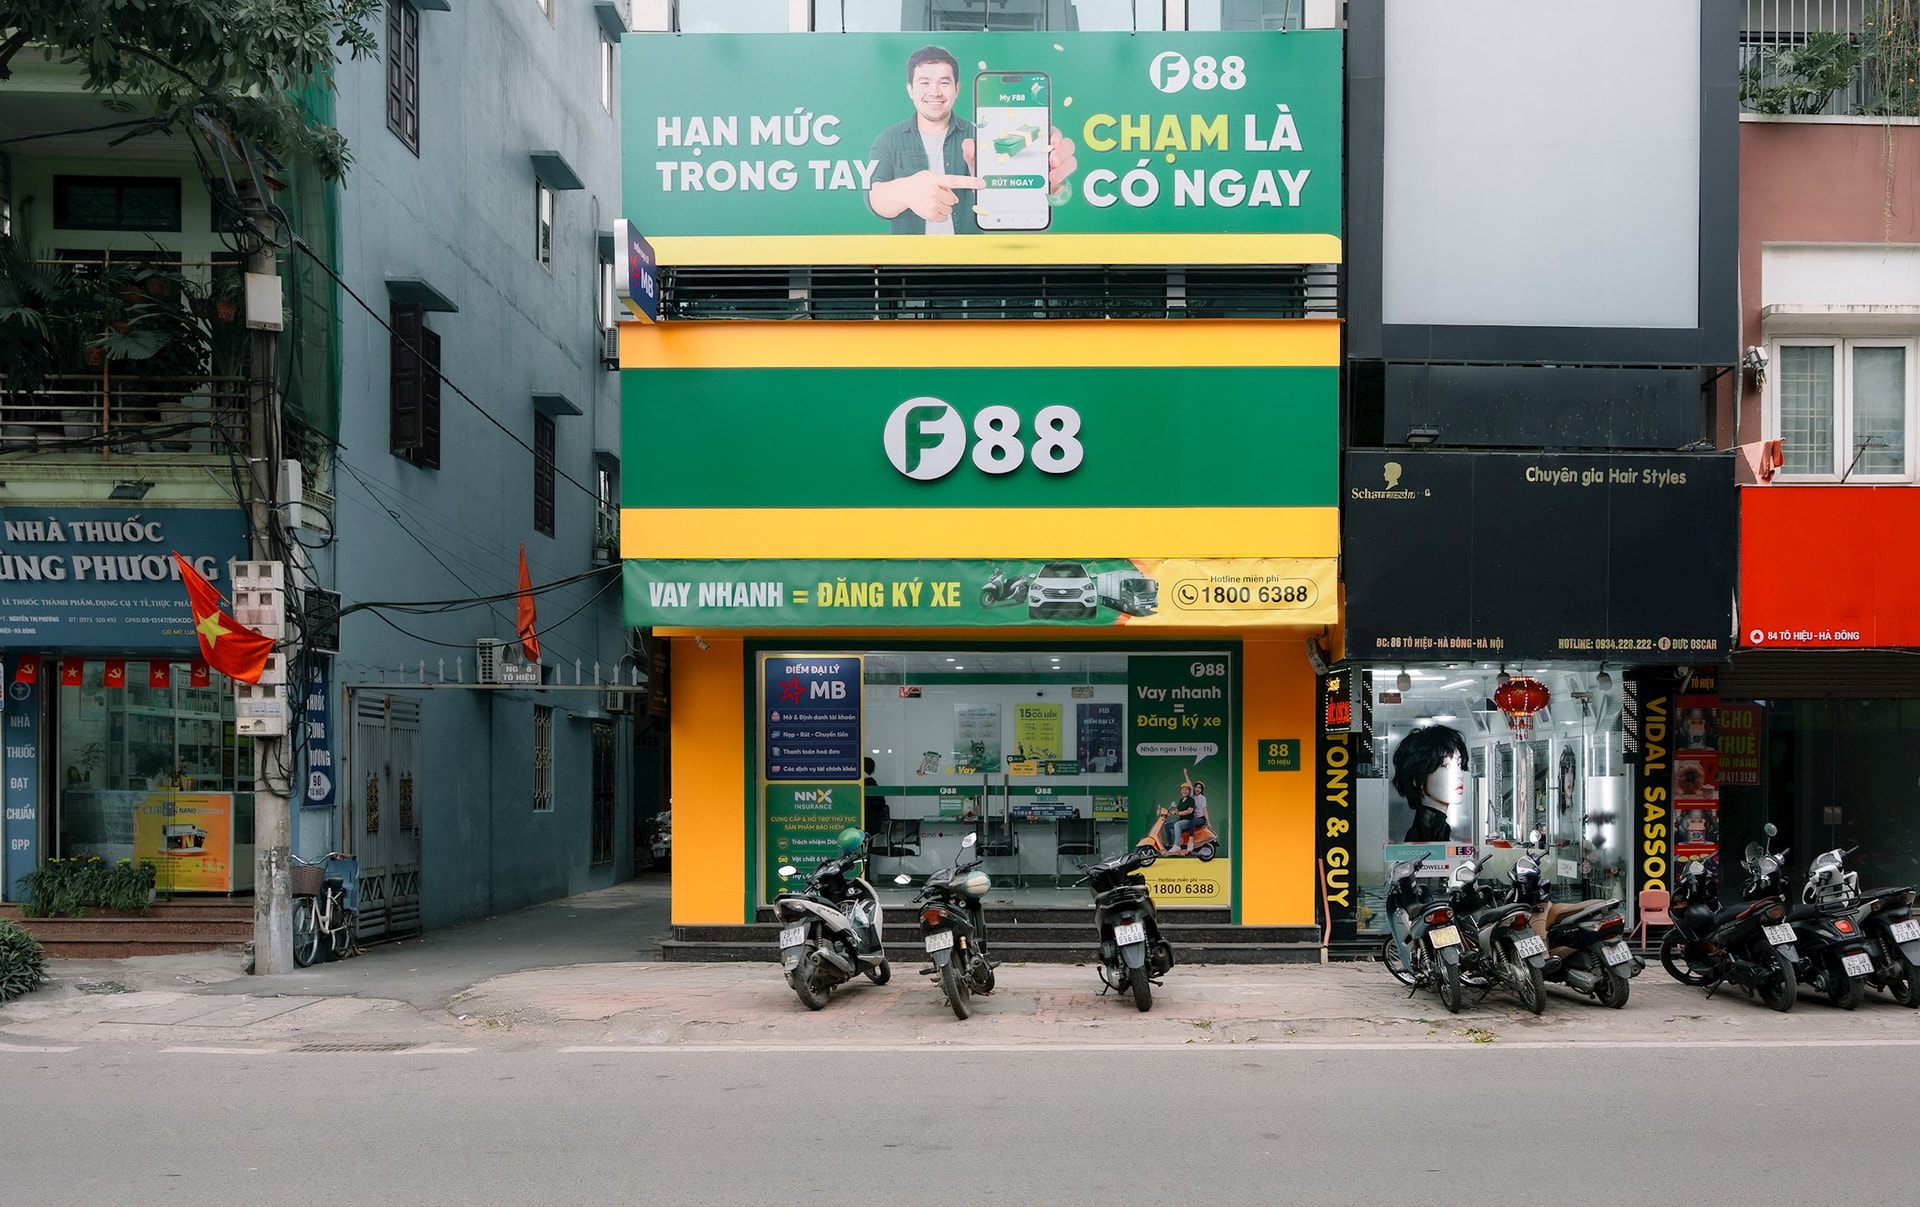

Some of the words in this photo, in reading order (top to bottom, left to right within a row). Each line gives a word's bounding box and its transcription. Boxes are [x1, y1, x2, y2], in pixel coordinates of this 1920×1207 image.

[1149, 51, 1246, 93] F88
[657, 116, 738, 156] HẠN
[750, 107, 841, 146] MỨC
[1083, 113, 1229, 164] CHẠM
[1245, 104, 1303, 151] LÀ
[656, 160, 798, 192] TRONG
[808, 159, 879, 191] TAY
[992, 176, 1007, 186] RÚT
[1083, 159, 1160, 207] CÓ
[1174, 169, 1311, 207] NGAY
[641, 267, 653, 298] MB
[884, 396, 1084, 480] F88
[1526, 466, 1577, 486] Chuyên
[1582, 468, 1603, 486] gia
[1609, 468, 1638, 483] Hair
[1642, 468, 1686, 488] Styles
[4, 516, 66, 542] NHÀ
[68, 514, 164, 542] THUỐC
[1210, 575, 1239, 583] Hotline
[1243, 574, 1265, 583] miễn
[1266, 574, 1280, 584] phí
[649, 582, 691, 607] VAY
[699, 582, 783, 607] NHANH
[817, 577, 884, 607] ĐĂNG
[892, 577, 923, 607] KÝ
[930, 582, 961, 607] XE
[1202, 586, 1250, 603] 1800
[1258, 586, 1308, 603] 6388
[13, 597, 39, 606] THUỐC
[1768, 632, 1777, 640] 84
[1780, 629, 1790, 640] TÔ
[1834, 630, 1859, 640] ĐÔNG
[1376, 637, 1389, 647] ĐC:
[1391, 637, 1400, 647] 86
[1403, 636, 1413, 647] TÔ
[1490, 637, 1504, 650] NỘI
[1558, 638, 1593, 649] HOTLINE:
[1690, 639, 1717, 649] OSCAR
[786, 664, 809, 674] ĐIỂM
[811, 666, 827, 676] ĐẠI
[829, 664, 840, 674] LÝ
[1190, 662, 1225, 677] F88
[503, 673, 513, 681] TÔ
[516, 673, 536, 682] HIỆU
[810, 681, 846, 700] MB
[1137, 686, 1167, 701] Vay
[1172, 686, 1222, 699] nhanh
[11, 714, 30, 728] NHÀ
[1137, 714, 1177, 730] Đăng
[1182, 713, 1199, 729] ký
[1203, 717, 1221, 727] xe
[1721, 710, 1752, 728] CHO
[815, 731, 836, 739] Chuyển
[1645, 696, 1667, 776] VIDAL
[6, 743, 35, 758] THUỐC
[1140, 745, 1159, 753] Nhận
[1269, 743, 1289, 757] 88
[1326, 733, 1349, 807] TONY
[11, 777, 28, 792] ĐẠT
[313, 775, 322, 786] 90
[940, 787, 956, 795] F88
[6, 804, 35, 820] CHUẨN
[1326, 816, 1349, 837] &
[12, 839, 30, 850] GPP
[1644, 786, 1666, 891] SASSOO
[1326, 847, 1349, 907] GUY
[1154, 884, 1181, 894] 1800
[1185, 884, 1214, 894] 6388
